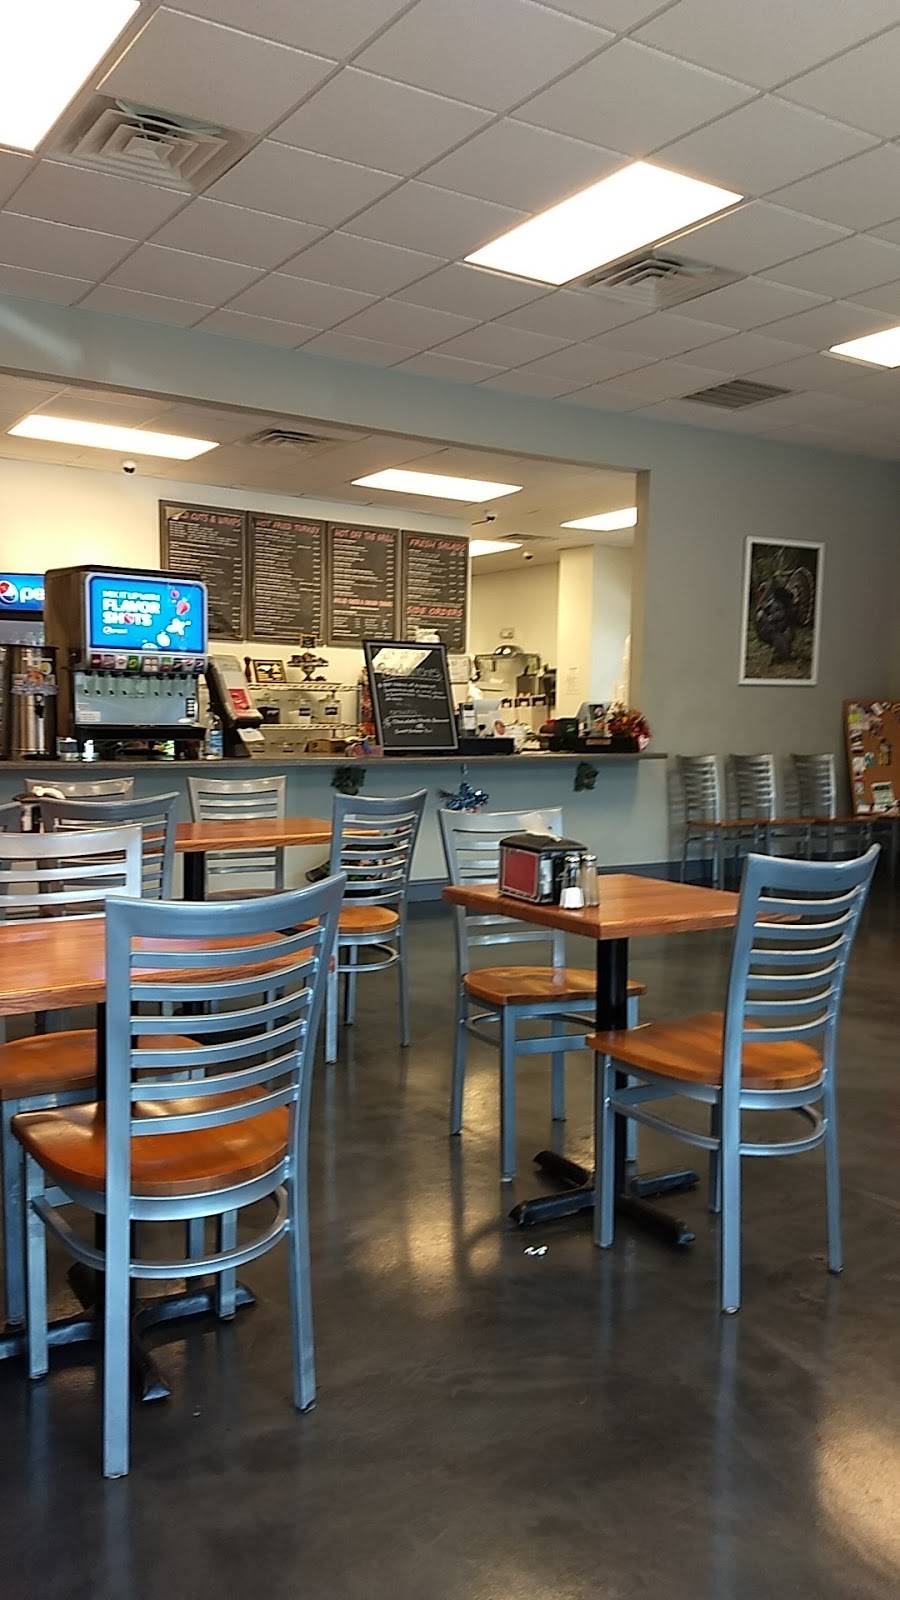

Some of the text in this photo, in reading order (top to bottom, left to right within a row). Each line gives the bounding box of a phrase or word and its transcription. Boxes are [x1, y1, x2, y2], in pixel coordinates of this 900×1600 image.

[334, 528, 350, 537] HOT
[409, 538, 437, 548] FRESH
[102, 598, 161, 614] FLAVOR
[407, 605, 464, 617] SIDE ORDERS
[102, 610, 153, 627] SHOTS
